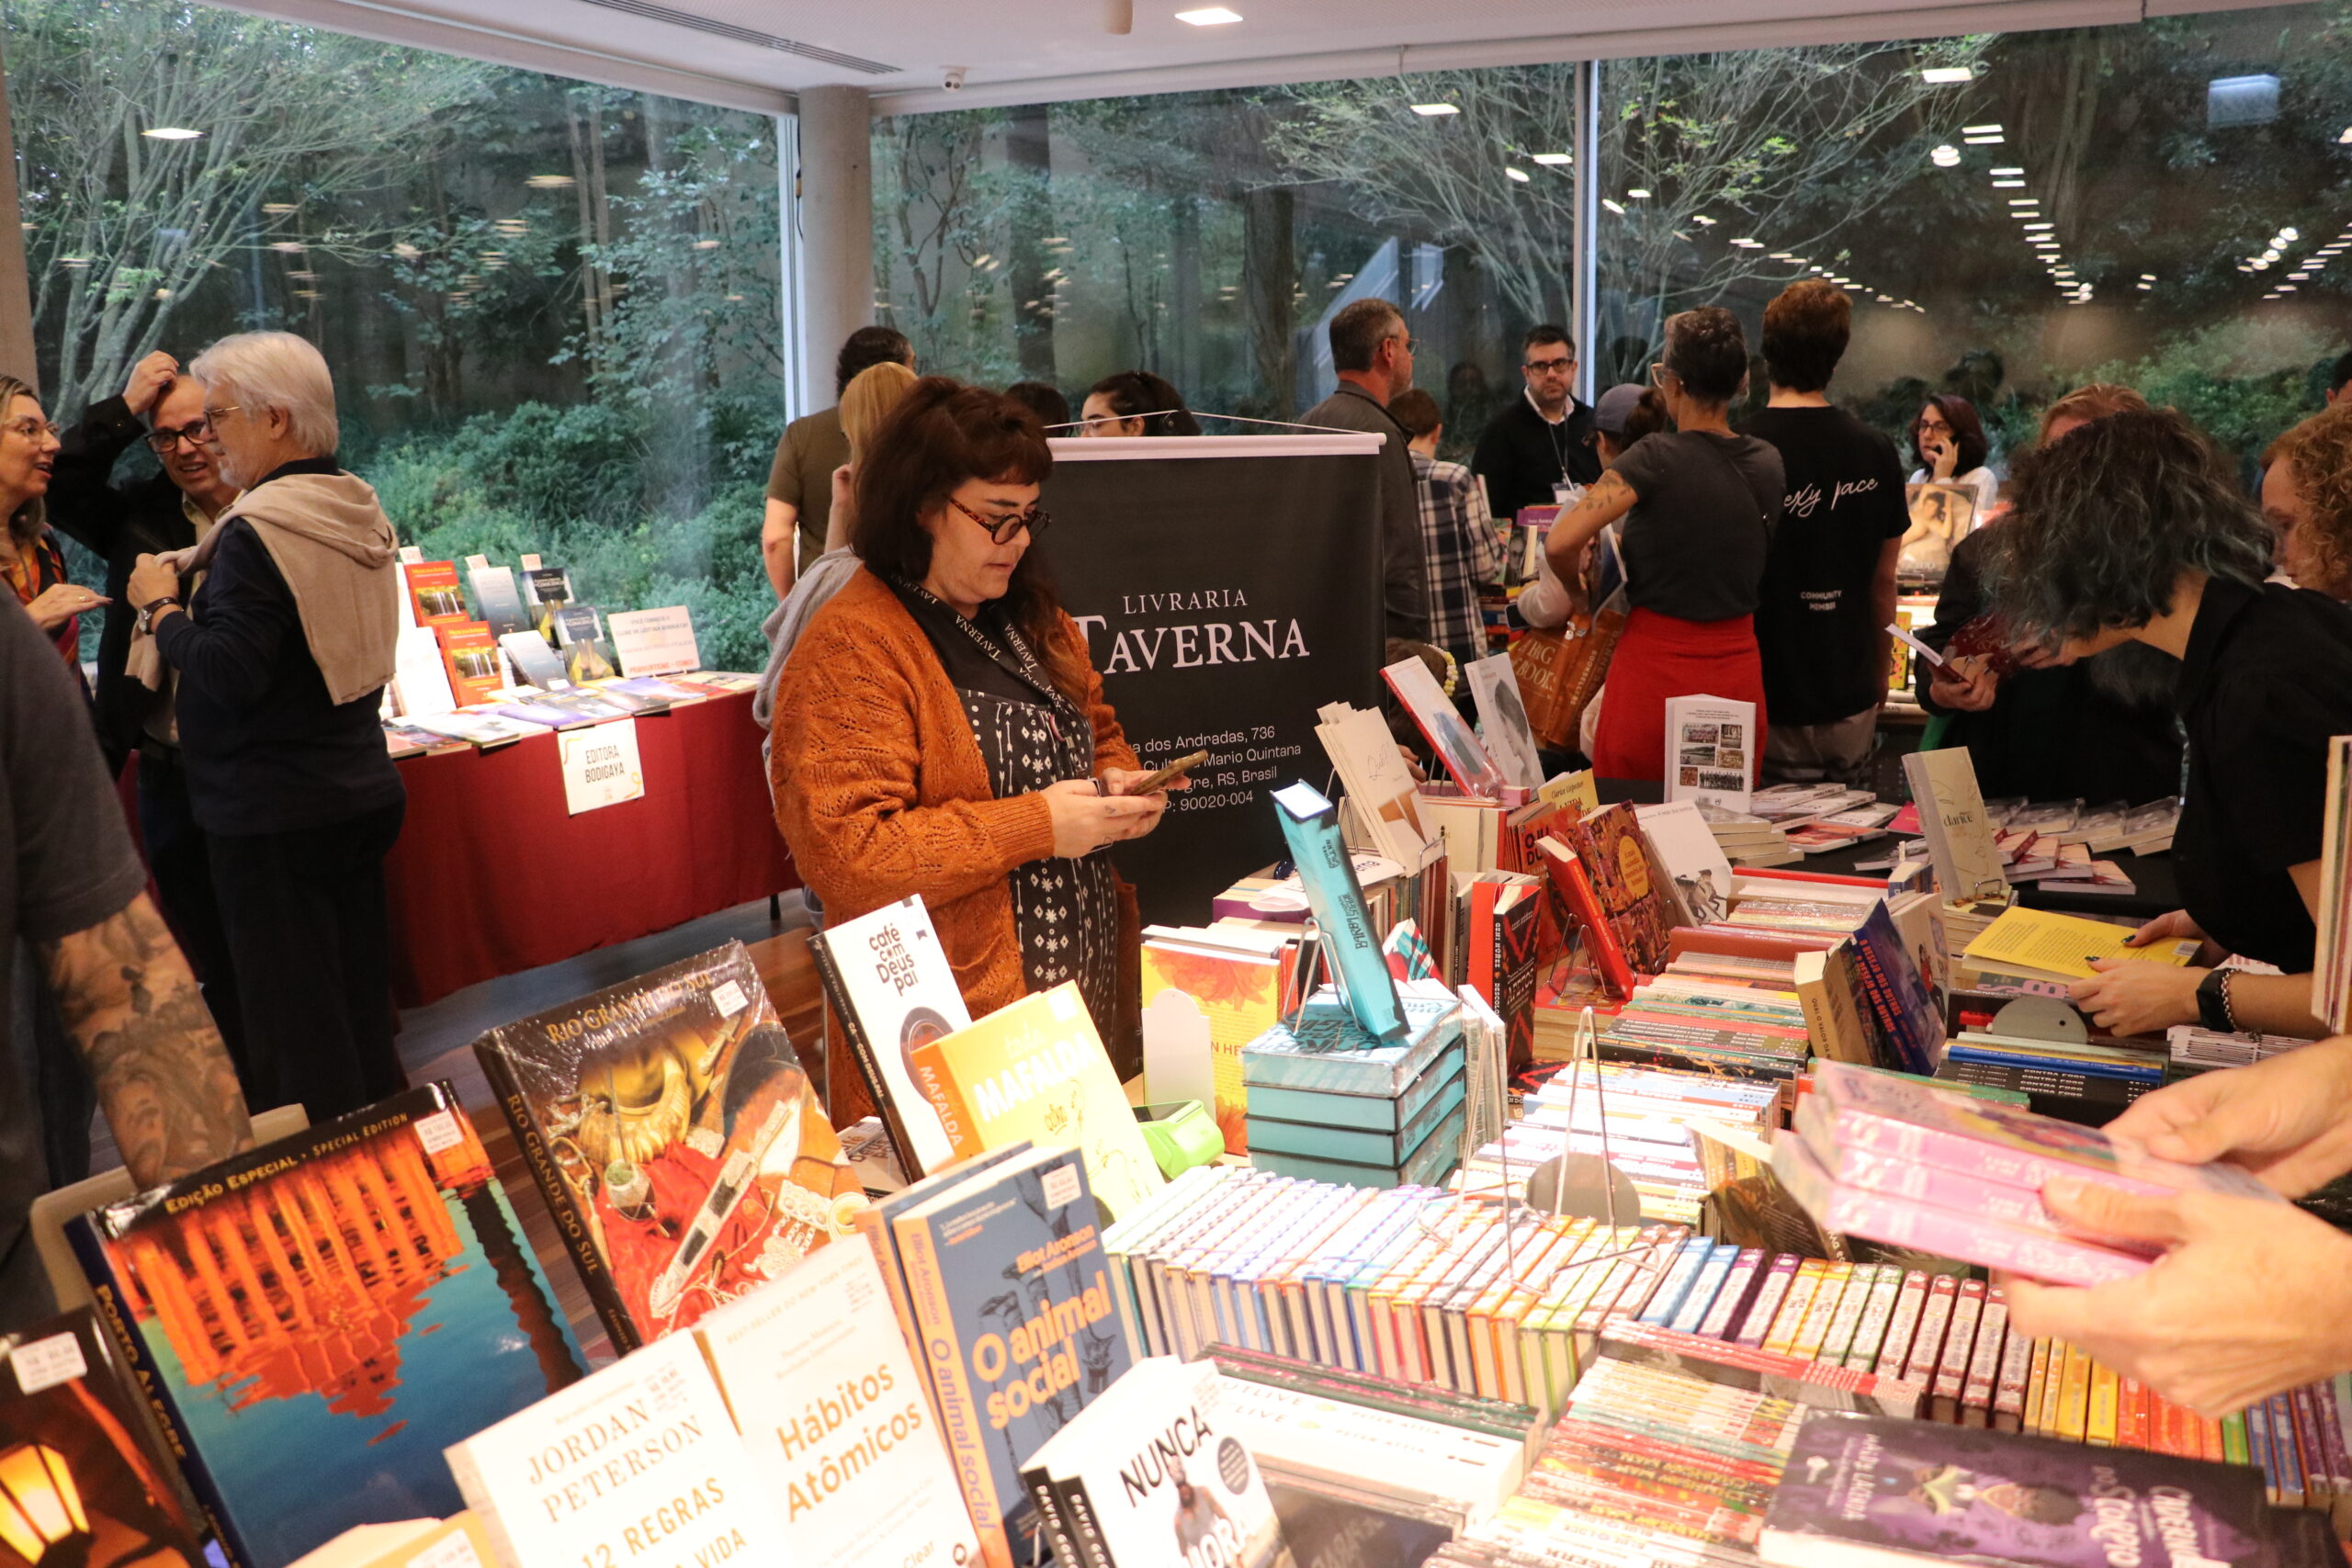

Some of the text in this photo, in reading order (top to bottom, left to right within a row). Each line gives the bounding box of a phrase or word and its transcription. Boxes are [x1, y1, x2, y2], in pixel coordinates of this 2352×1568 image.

[1783, 483, 1821, 517] exy
[1123, 589, 1249, 615] LIVRARIA
[956, 615, 1001, 661] TAVERNA
[1004, 623, 1038, 674] TAVERNA
[1072, 615, 1310, 675] TAVERNA
[1529, 640, 1556, 666] BIG
[1570, 649, 1598, 705] BOOKSELLERS
[585, 745, 619, 764] EDITORA
[1145, 725, 1276, 752] dos Andradas, 736
[1204, 750, 1244, 768] Mario
[1246, 744, 1302, 762] Quintana
[584, 762, 625, 783] BODIGAYA
[1217, 773, 1239, 787] RS,
[1242, 766, 1278, 784] Brasil
[1180, 790, 1254, 812] 90020-004
[868, 922, 901, 952] café
[878, 942, 906, 963] com
[876, 954, 915, 984] Deus
[894, 973, 920, 998] pai
[1862, 945, 1882, 973] DESEJO
[1875, 973, 1889, 988] DOS
[1883, 987, 1903, 1017] OUTROS
[546, 1018, 582, 1045] RIO
[683, 969, 716, 991] SUL
[1870, 989, 1883, 1005] DOS
[1877, 1005, 1896, 1032] OUTROS
[972, 1031, 1102, 1123] MAFALDA
[920, 1066, 965, 1148] MAFALDA
[165, 1184, 224, 1215] EDIÇÃO
[226, 1156, 299, 1190] ESPECIAL
[311, 1131, 360, 1157] SPECIAL
[363, 1111, 408, 1137] EDITION
[508, 1094, 599, 1276] RIO GRANDE DO SUL
[1046, 1224, 1097, 1258] Aronson
[910, 1233, 942, 1325] Elliot Aronson
[96, 1283, 139, 1364] PORTO
[972, 1269, 1113, 1382] O animal
[986, 1335, 1081, 1430] social
[1223, 1381, 1304, 1406] UTLIVE
[776, 1363, 894, 1461] Hábitos
[931, 1337, 997, 1529] O animal social
[527, 1398, 650, 1485] JORDAN
[788, 1402, 922, 1524] Atômicos
[1119, 1405, 1213, 1508] NUNCA
[541, 1415, 704, 1524] PETERSON
[581, 1476, 726, 1568] 12 REGRAS
[1035, 1484, 1061, 1529] DAVID
[1070, 1493, 1096, 1539] DAVID
[695, 1528, 748, 1568] VIDA
[903, 1540, 936, 1568] Clear
